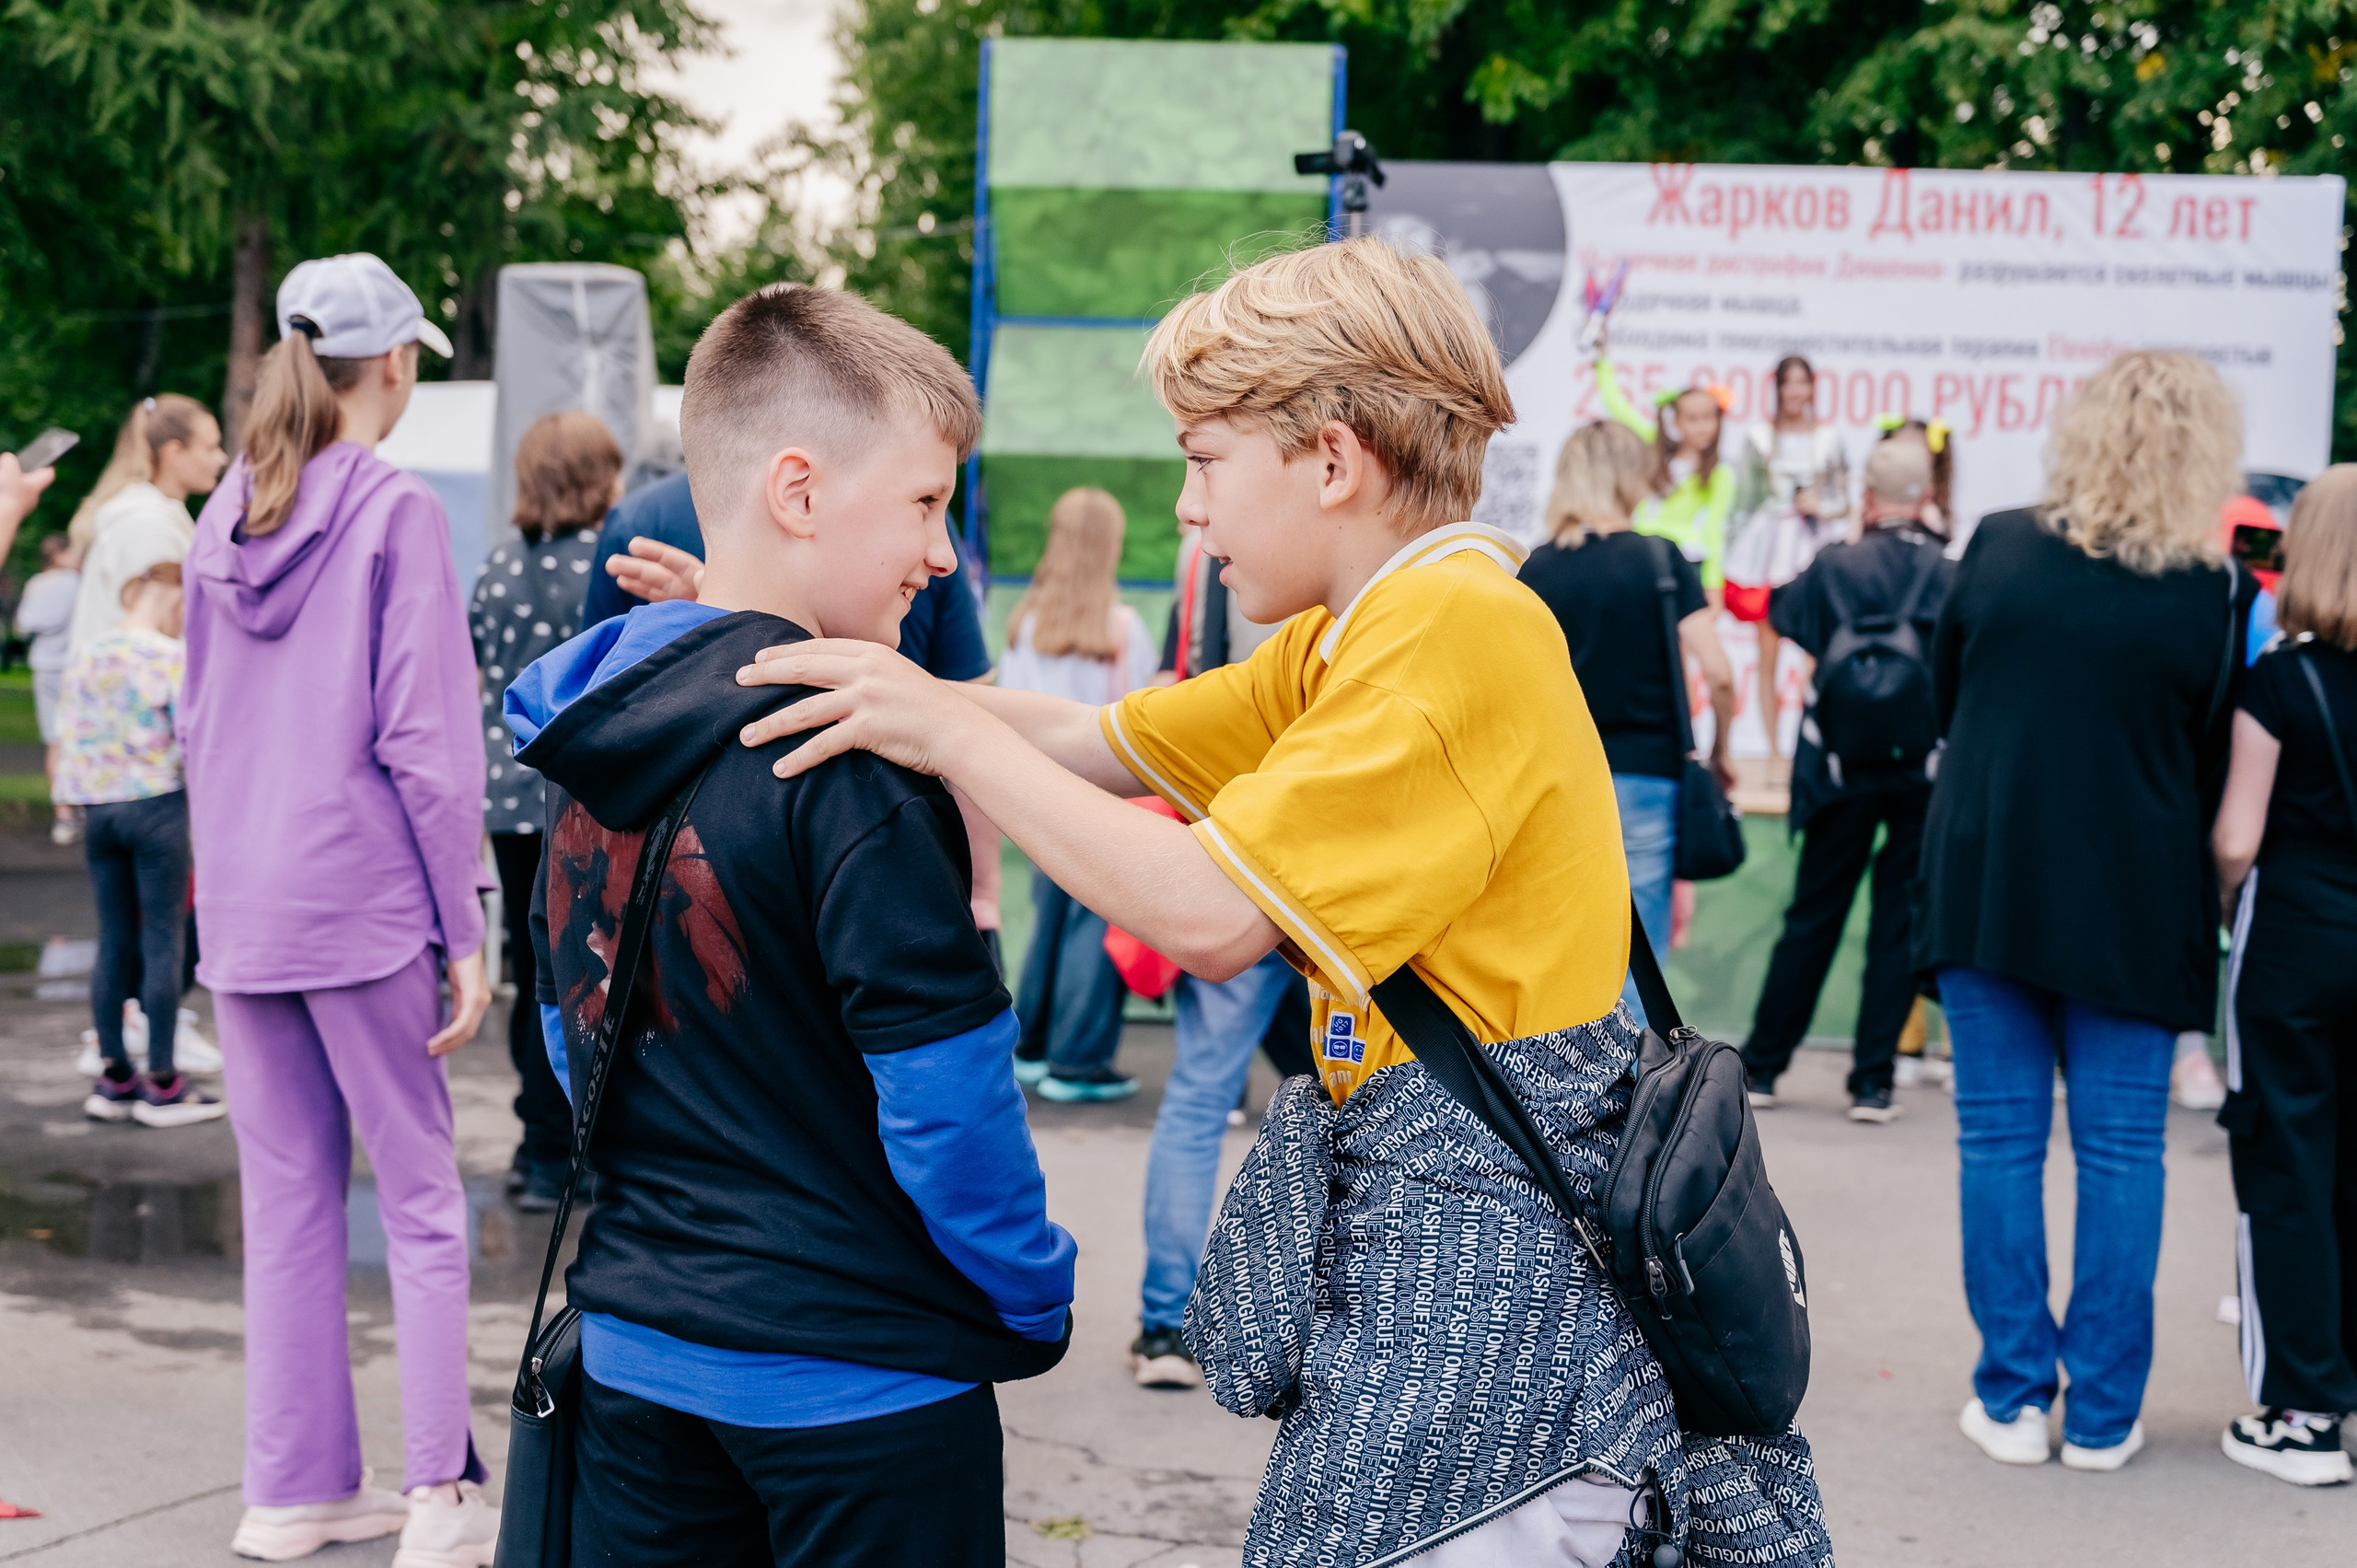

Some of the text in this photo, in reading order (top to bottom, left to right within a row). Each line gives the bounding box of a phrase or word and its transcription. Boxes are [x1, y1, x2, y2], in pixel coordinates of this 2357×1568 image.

[1647, 162, 2258, 243] Жарков Данил, 12 лет
[1333, 1017, 1343, 1028] UG
[1335, 1020, 1349, 1033] 1017
